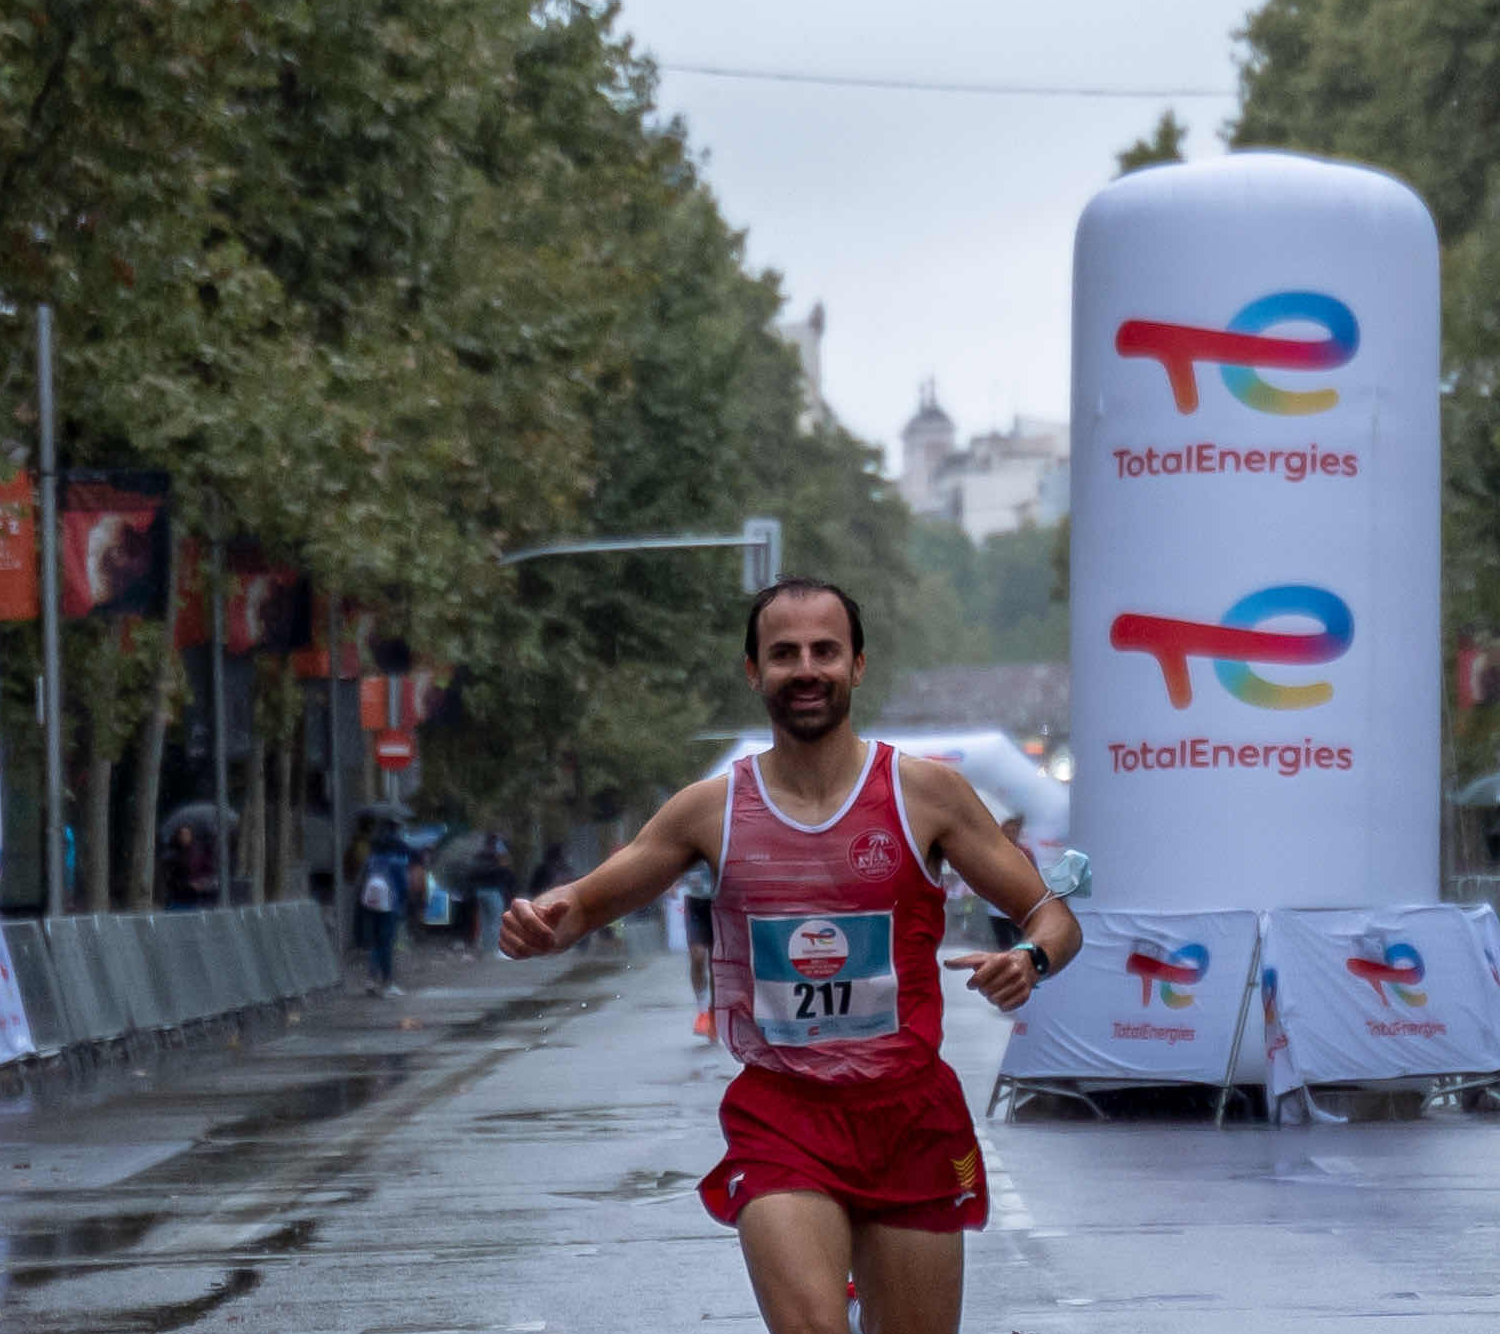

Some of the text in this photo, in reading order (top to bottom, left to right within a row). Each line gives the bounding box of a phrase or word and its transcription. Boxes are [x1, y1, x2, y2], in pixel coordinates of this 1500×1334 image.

[1114, 444, 1358, 482] TotalEnergies
[1108, 738, 1352, 776] TotalEnergies
[794, 982, 852, 1019] 217
